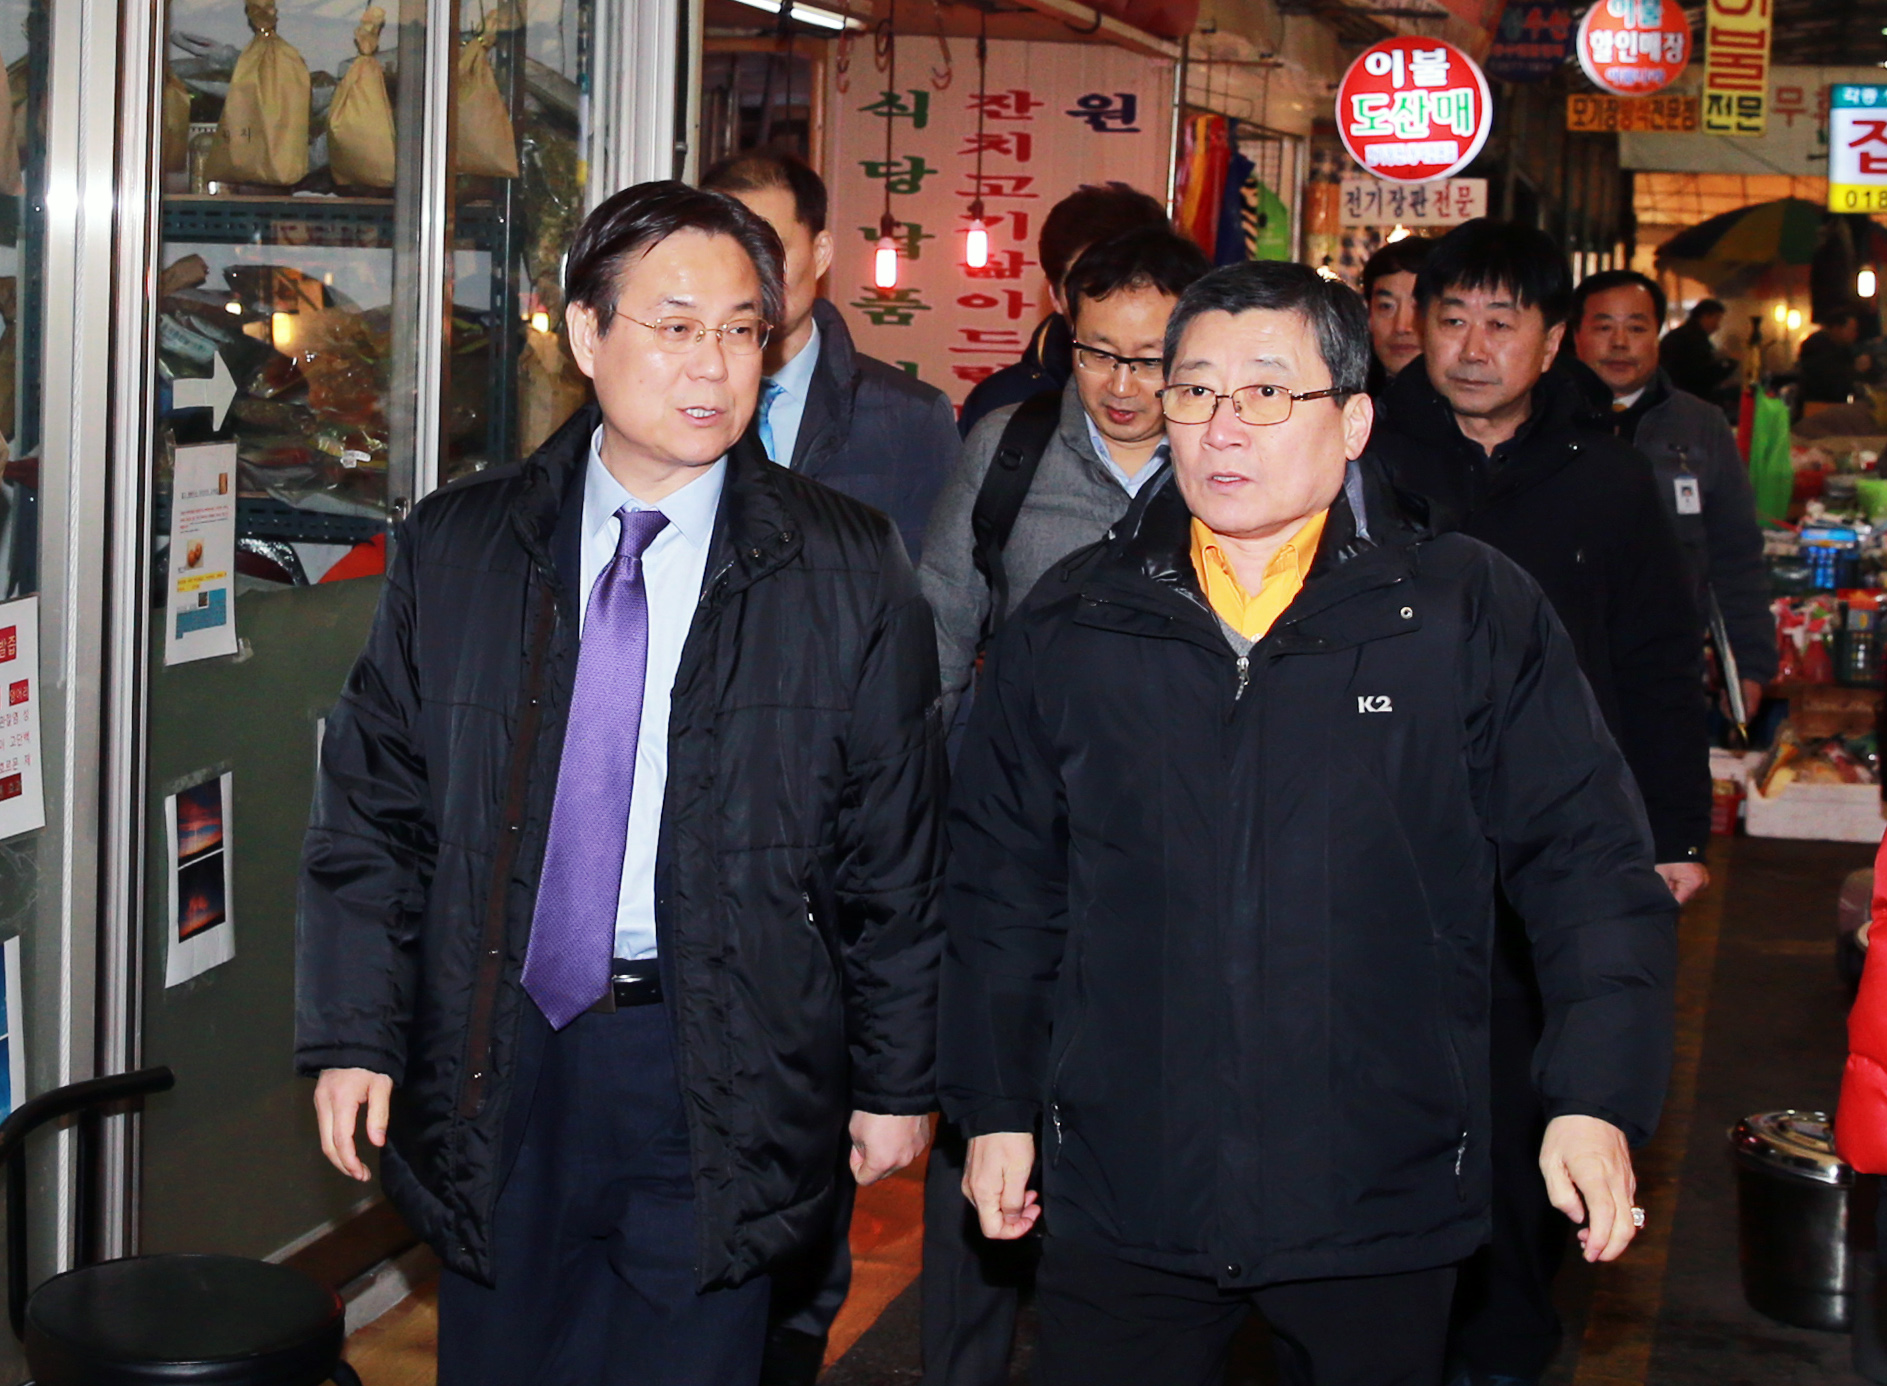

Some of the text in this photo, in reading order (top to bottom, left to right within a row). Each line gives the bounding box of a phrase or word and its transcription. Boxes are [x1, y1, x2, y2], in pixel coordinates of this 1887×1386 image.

[1588, 30, 1685, 64] 할인매장
[1364, 48, 1451, 89] 이불
[1350, 87, 1476, 140] 도산매
[1707, 94, 1762, 132] 전문
[1357, 695, 1393, 713] K2
